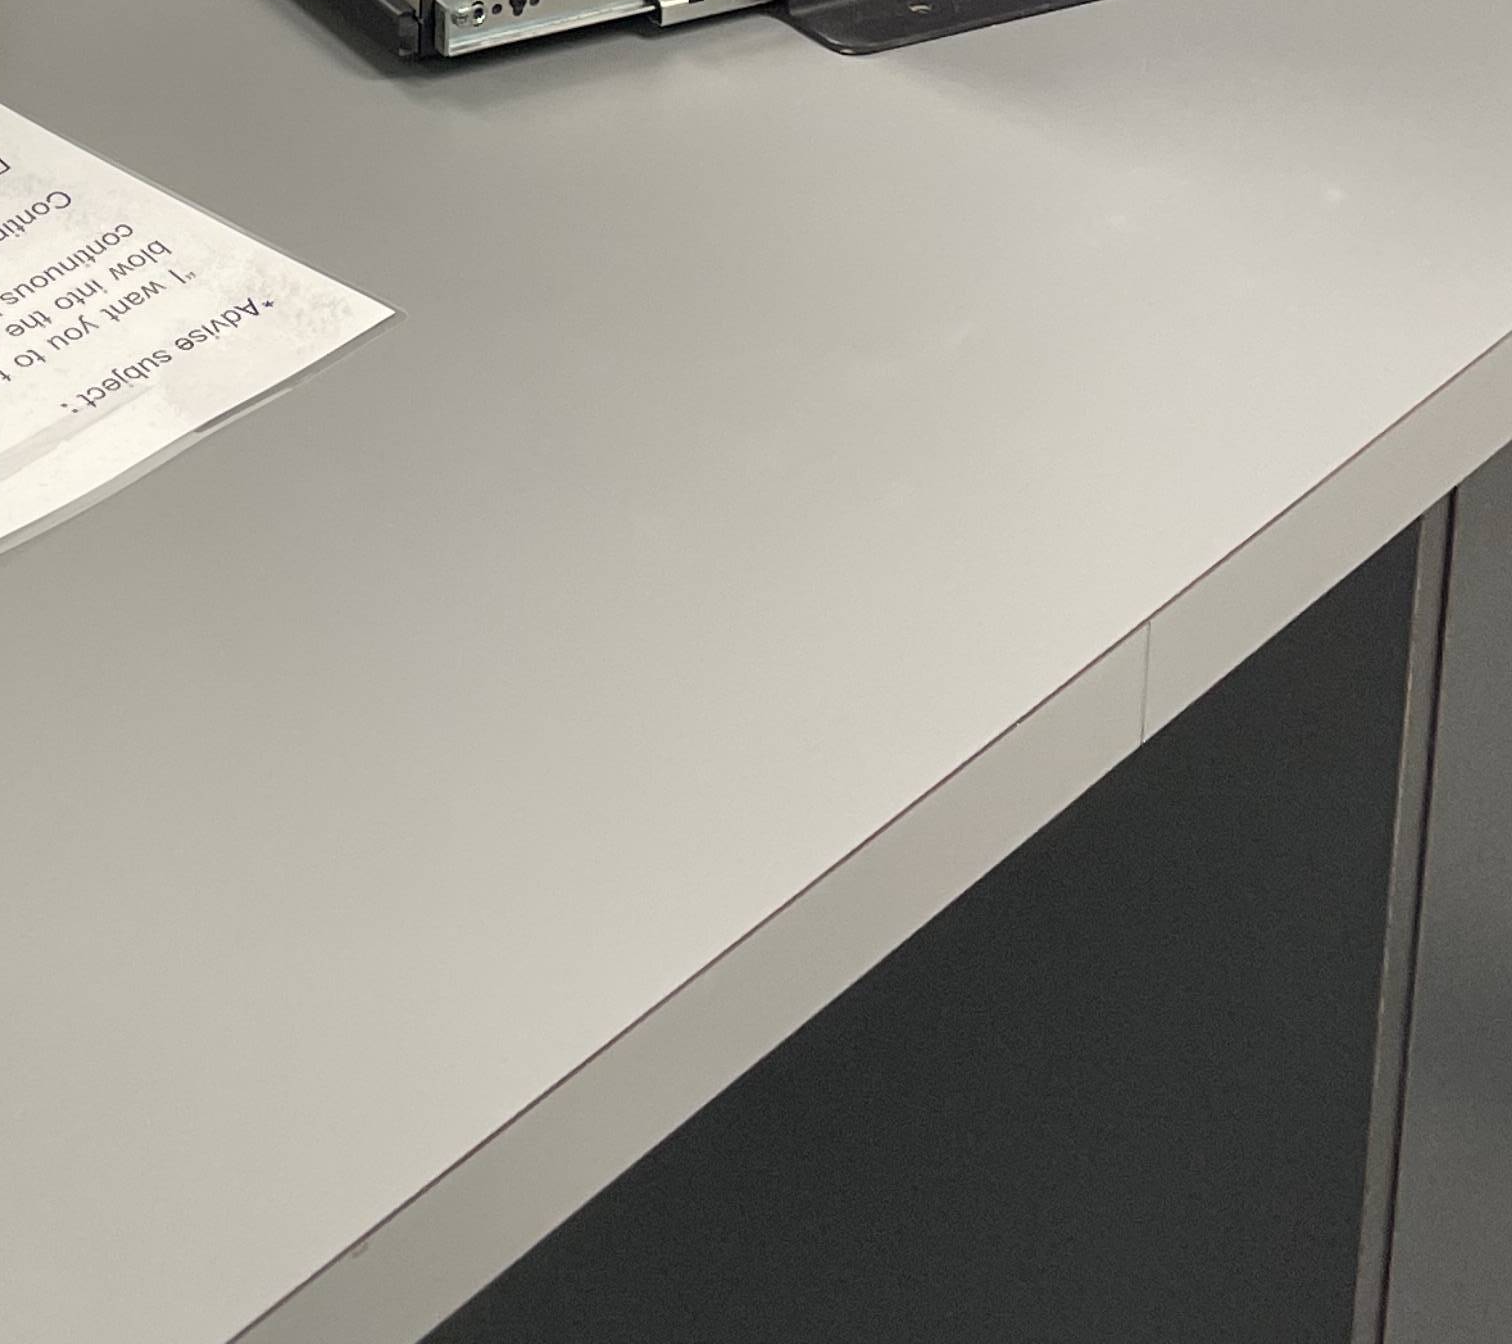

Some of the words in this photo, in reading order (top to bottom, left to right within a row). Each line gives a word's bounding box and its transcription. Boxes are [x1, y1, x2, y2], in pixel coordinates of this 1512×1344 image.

[108, 239, 173, 282] blow
[53, 278, 109, 311] into
[99, 280, 168, 323] want
[4, 309, 53, 338] the
[45, 313, 101, 351] you
[13, 348, 47, 368] to
[75, 349, 173, 409] subject
